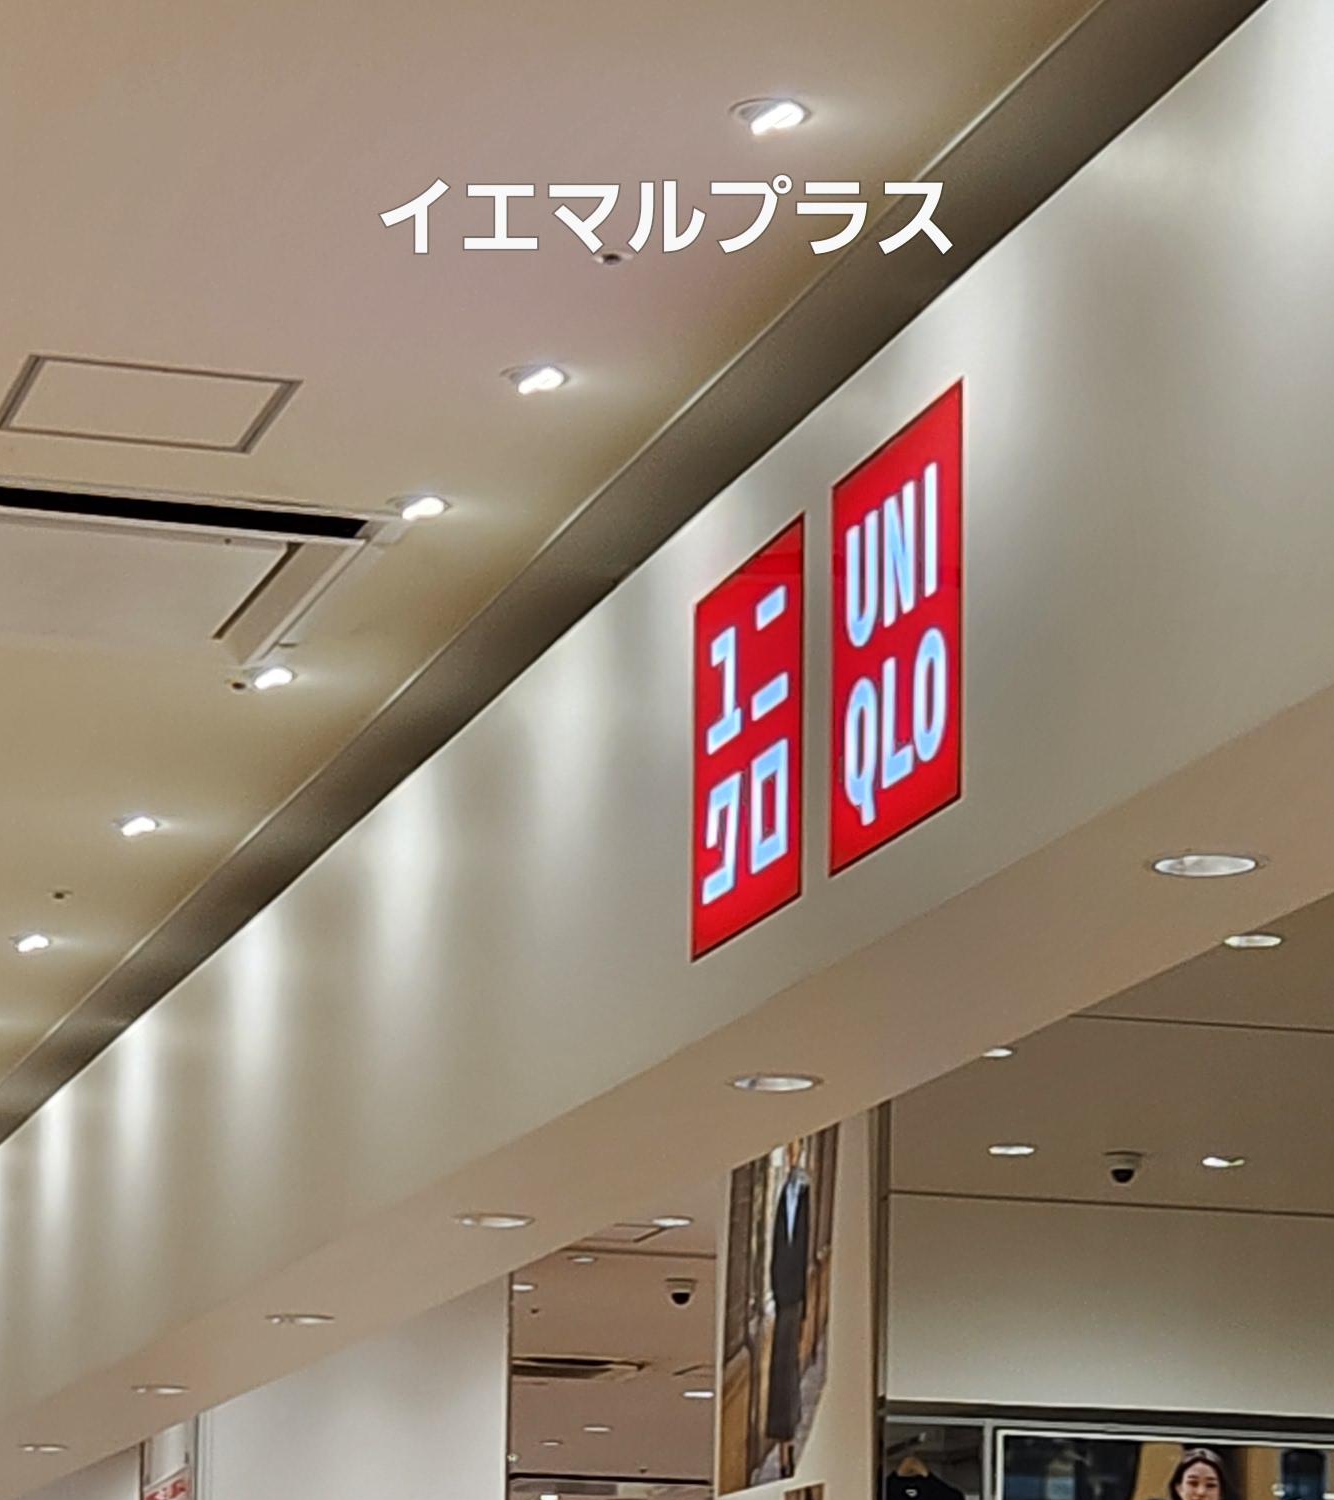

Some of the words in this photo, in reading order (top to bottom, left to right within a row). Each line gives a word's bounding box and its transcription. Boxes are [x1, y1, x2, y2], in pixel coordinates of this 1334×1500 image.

[844, 460, 940, 649] UNI
[705, 583, 789, 757] ユニ
[844, 625, 949, 827] QLO
[700, 736, 789, 907] クロ
